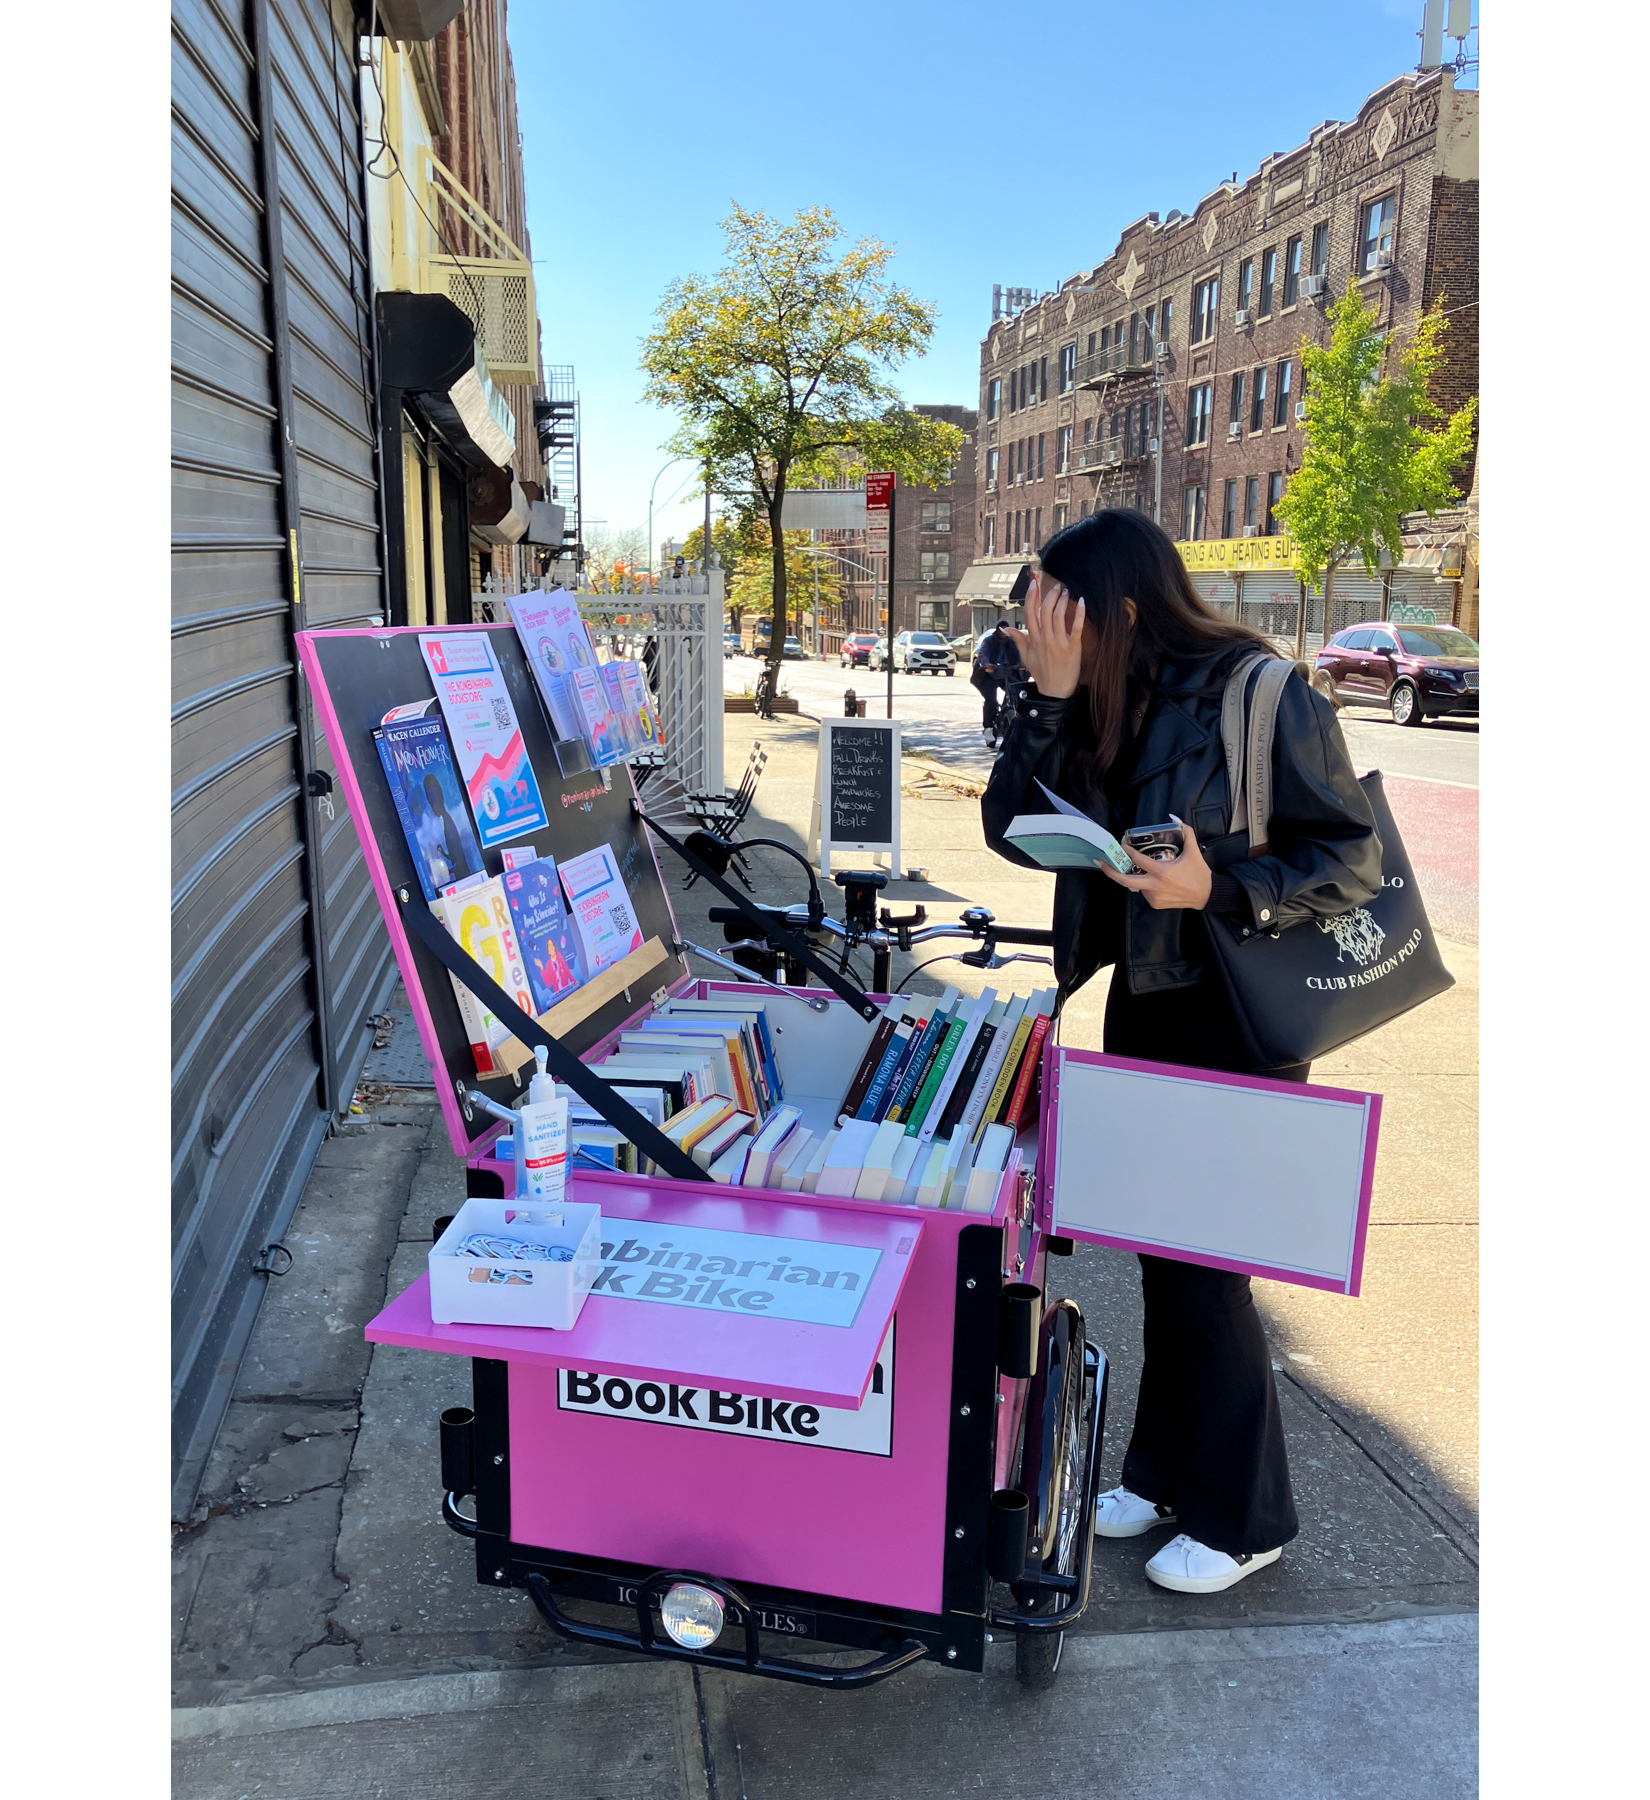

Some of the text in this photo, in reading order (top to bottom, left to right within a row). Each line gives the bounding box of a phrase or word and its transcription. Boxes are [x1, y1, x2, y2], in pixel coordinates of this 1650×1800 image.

[1209, 544, 1225, 561] AND
[1233, 542, 1270, 561] HEATING
[1275, 540, 1302, 558] SUPP
[444, 678, 493, 692] THE NONBINARIAN
[448, 691, 484, 705] BOOKSTORE
[388, 730, 409, 742] KACEN
[409, 724, 441, 738] CALLENDER
[1258, 712, 1267, 744] POLO
[380, 742, 392, 772] CALLENDER
[394, 744, 449, 774] MOONFLOWER
[832, 748, 852, 763] FALL
[1256, 746, 1265, 796] FASHION
[834, 796, 875, 812] AWESOME
[834, 811, 867, 828] PEOPLE
[528, 891, 546, 908] Who Is
[524, 900, 559, 928] Amy Schneider?
[1306, 928, 1422, 990] CLUB FASHION POLO
[461, 992, 472, 1024] Winston
[930, 1042, 940, 1054] OUT
[935, 1023, 962, 1071] GREEN DOT
[999, 1029, 1008, 1041] THE
[908, 1047, 927, 1076] SCOTCH
[968, 1044, 985, 1072] Penny Aimes
[990, 1041, 1003, 1063] ADULT
[865, 1048, 898, 1107] RAMONA BLUE
[916, 1058, 932, 1086] DROWNING
[975, 1066, 993, 1100] BRONWYN
[989, 1036, 1022, 1109] THE FORBIDDEN BOOK
[894, 1076, 913, 1106] VERDICT
[536, 1121, 558, 1131] HAND
[966, 1098, 981, 1126] FISCHER
[528, 1129, 566, 1142] SANITIZER
[636, 1271, 774, 1310] Bike
[566, 1370, 819, 1437] Book Bike
